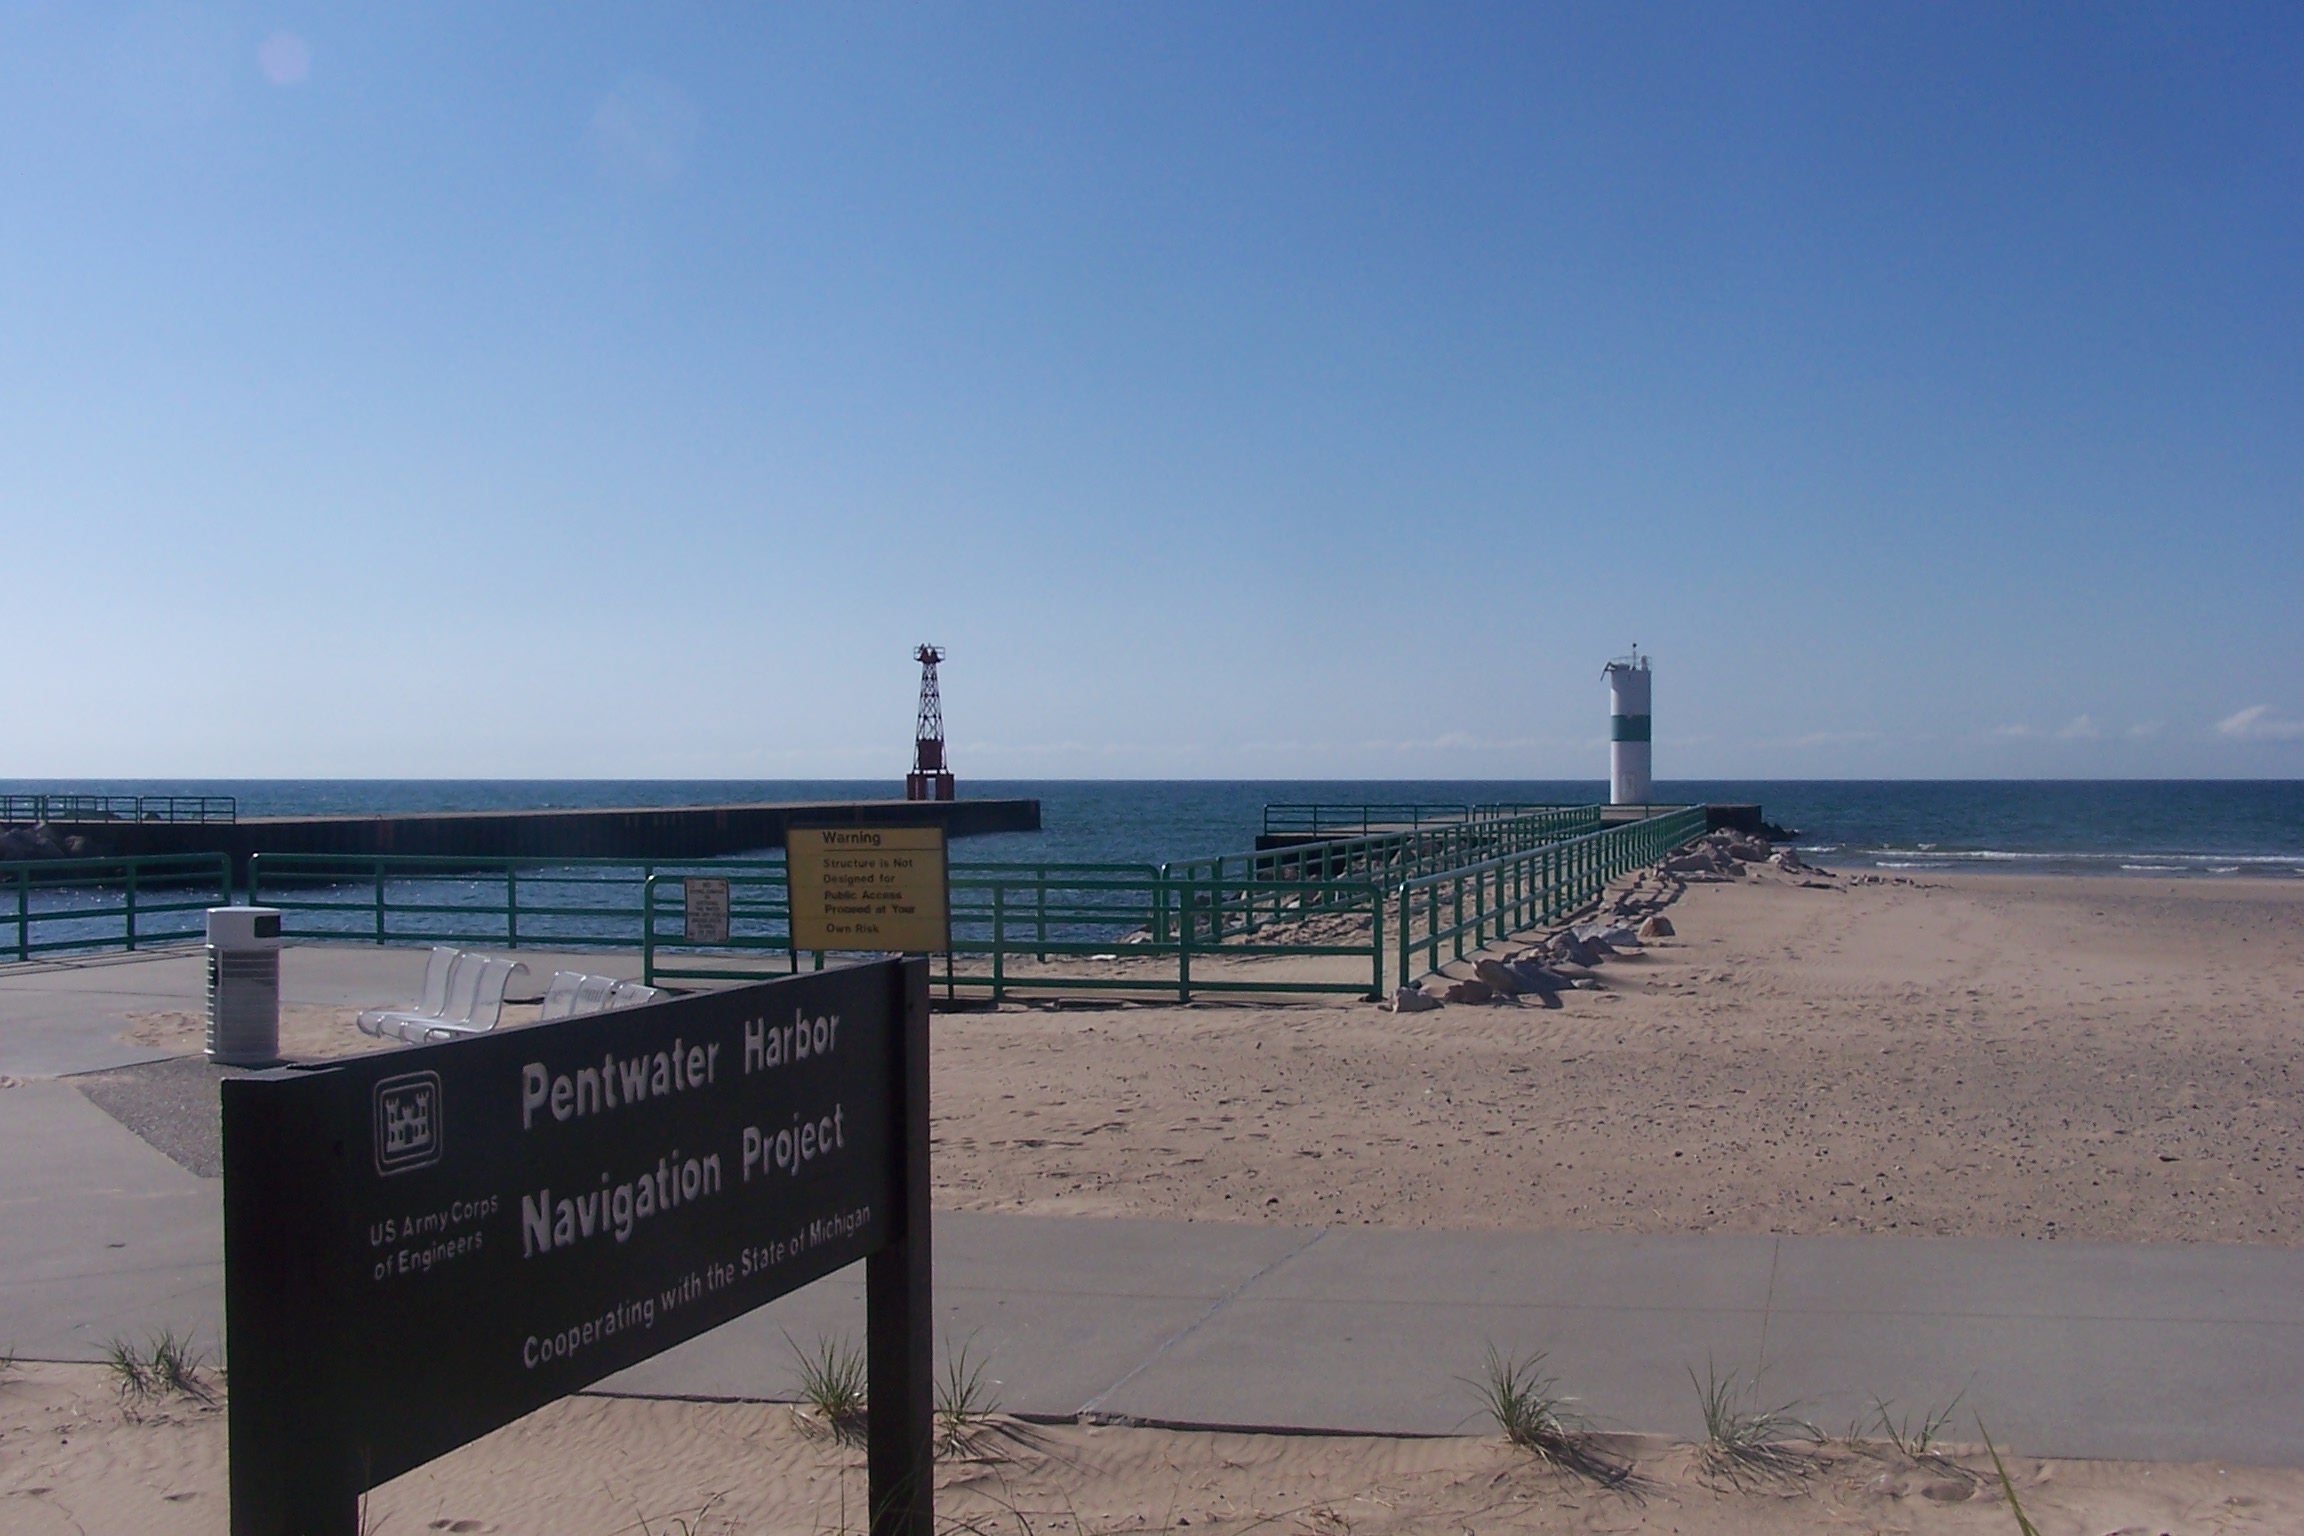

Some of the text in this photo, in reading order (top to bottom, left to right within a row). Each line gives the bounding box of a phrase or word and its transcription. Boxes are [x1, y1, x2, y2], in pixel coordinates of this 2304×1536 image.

[823, 830, 881, 846] Warning
[823, 857, 913, 868] Structure is Not
[823, 873, 896, 885] Designed for
[824, 889, 857, 900] Public
[824, 903, 916, 914] Proceed at Your
[826, 922, 880, 934] Own Risk
[522, 1008, 840, 1131] Pentwater Harbor
[521, 1103, 845, 1260] Navigation Project
[369, 1194, 499, 1248] US Army Corps
[374, 1229, 484, 1281] of Engineers
[523, 1204, 872, 1369] Cooperating with the State of Michigan
